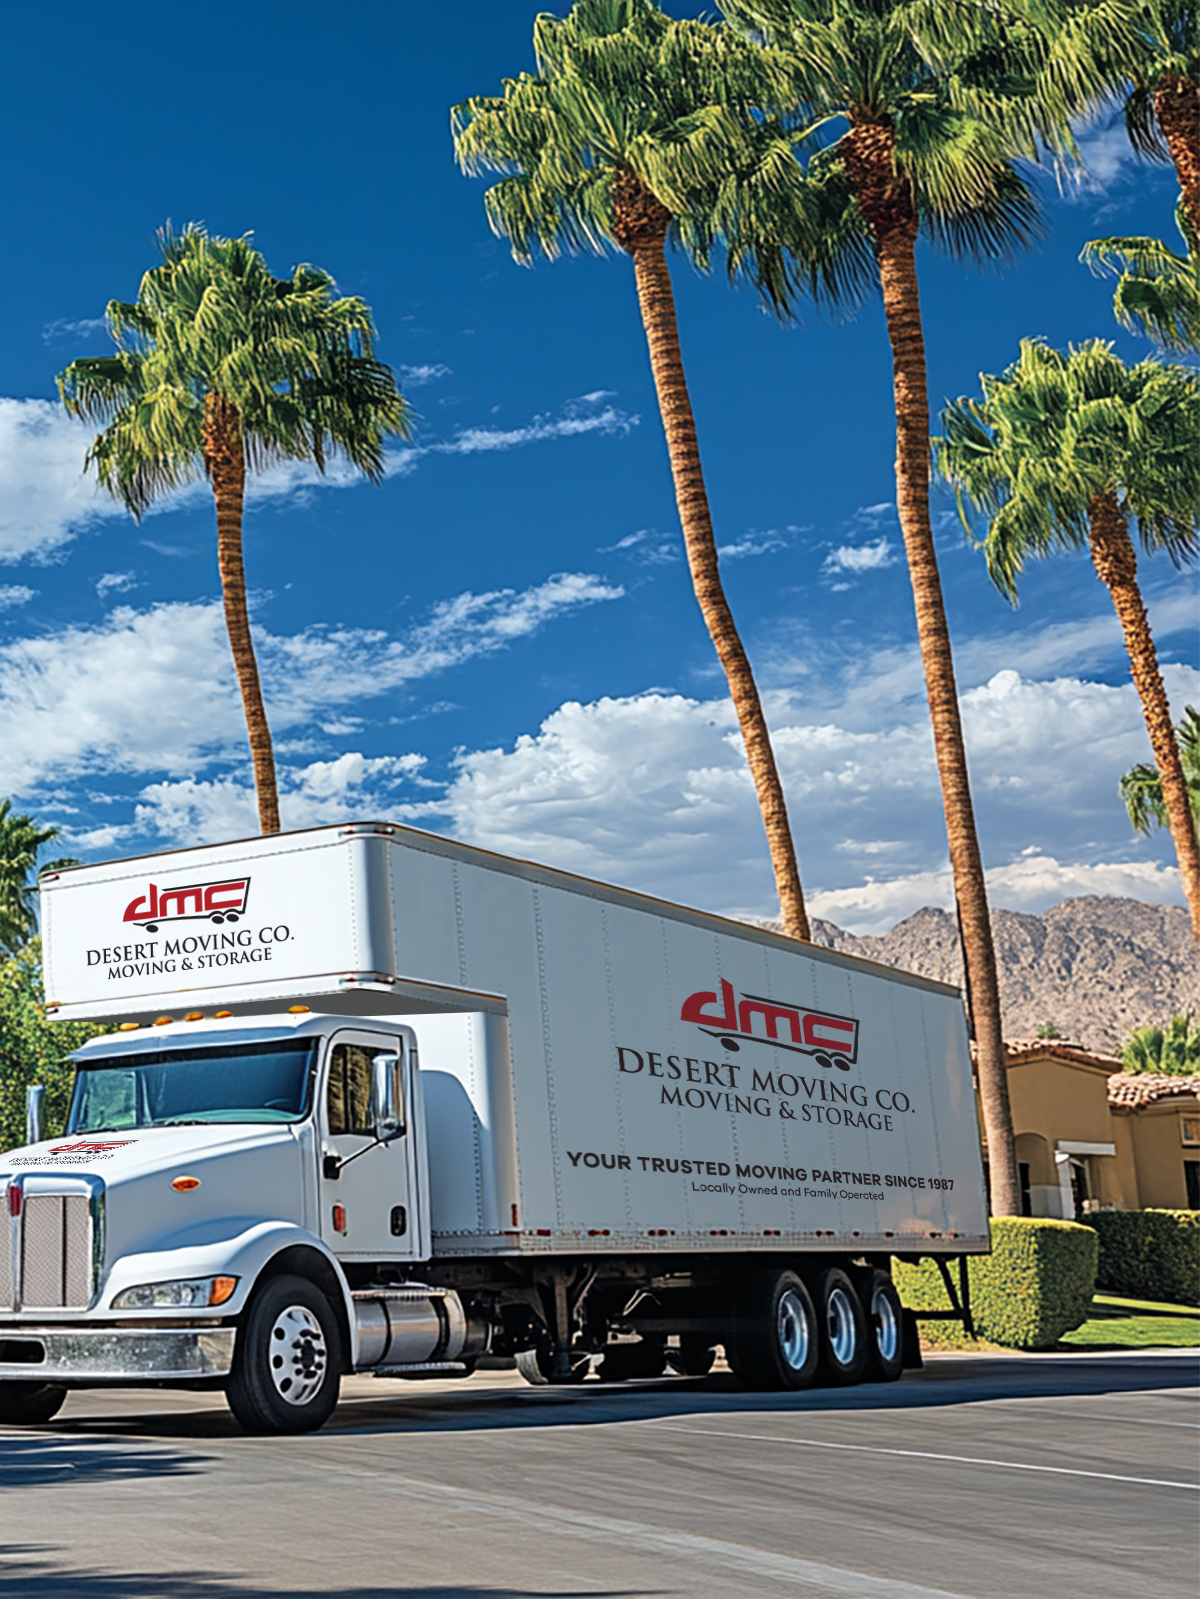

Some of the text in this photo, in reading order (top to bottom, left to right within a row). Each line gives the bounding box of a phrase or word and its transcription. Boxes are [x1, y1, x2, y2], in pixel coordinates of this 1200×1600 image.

[122, 882, 246, 922] dmc
[86, 925, 295, 966] DESERT MOVING CO.
[108, 947, 272, 979] MOVING & STORAGE
[680, 976, 854, 1053] dmc
[615, 1046, 916, 1114] DESERT MOVING CO.
[660, 1084, 894, 1132] MOVING & STORAGE
[566, 1150, 954, 1191] YOUR TRUSTED MOVING PARTNER SINCE 1987
[691, 1181, 884, 1201] Locally Owned and Family Operated
